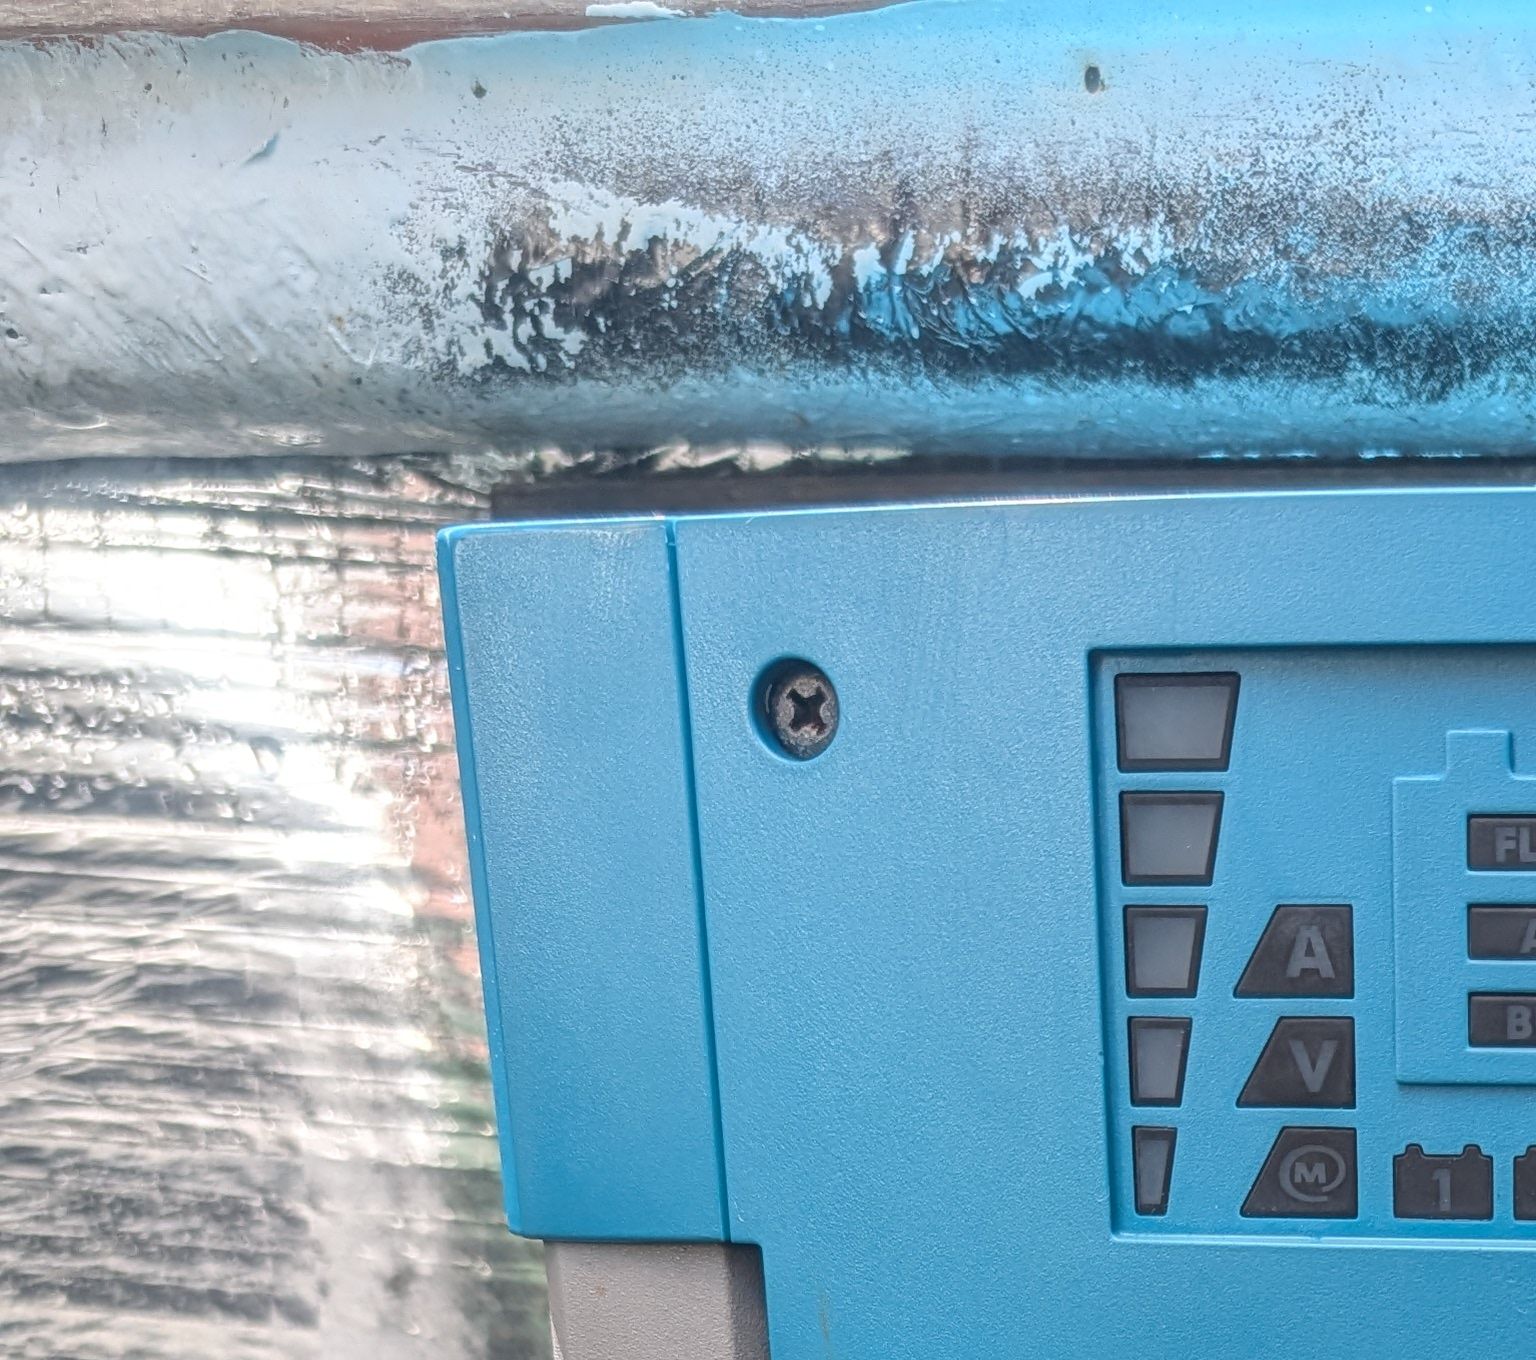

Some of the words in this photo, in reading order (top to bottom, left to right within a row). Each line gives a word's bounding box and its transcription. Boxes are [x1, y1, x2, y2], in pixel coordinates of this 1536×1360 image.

[1285, 925, 1336, 980] A
[1288, 1039, 1338, 1093] V
[1431, 1167, 1451, 1213] 1
